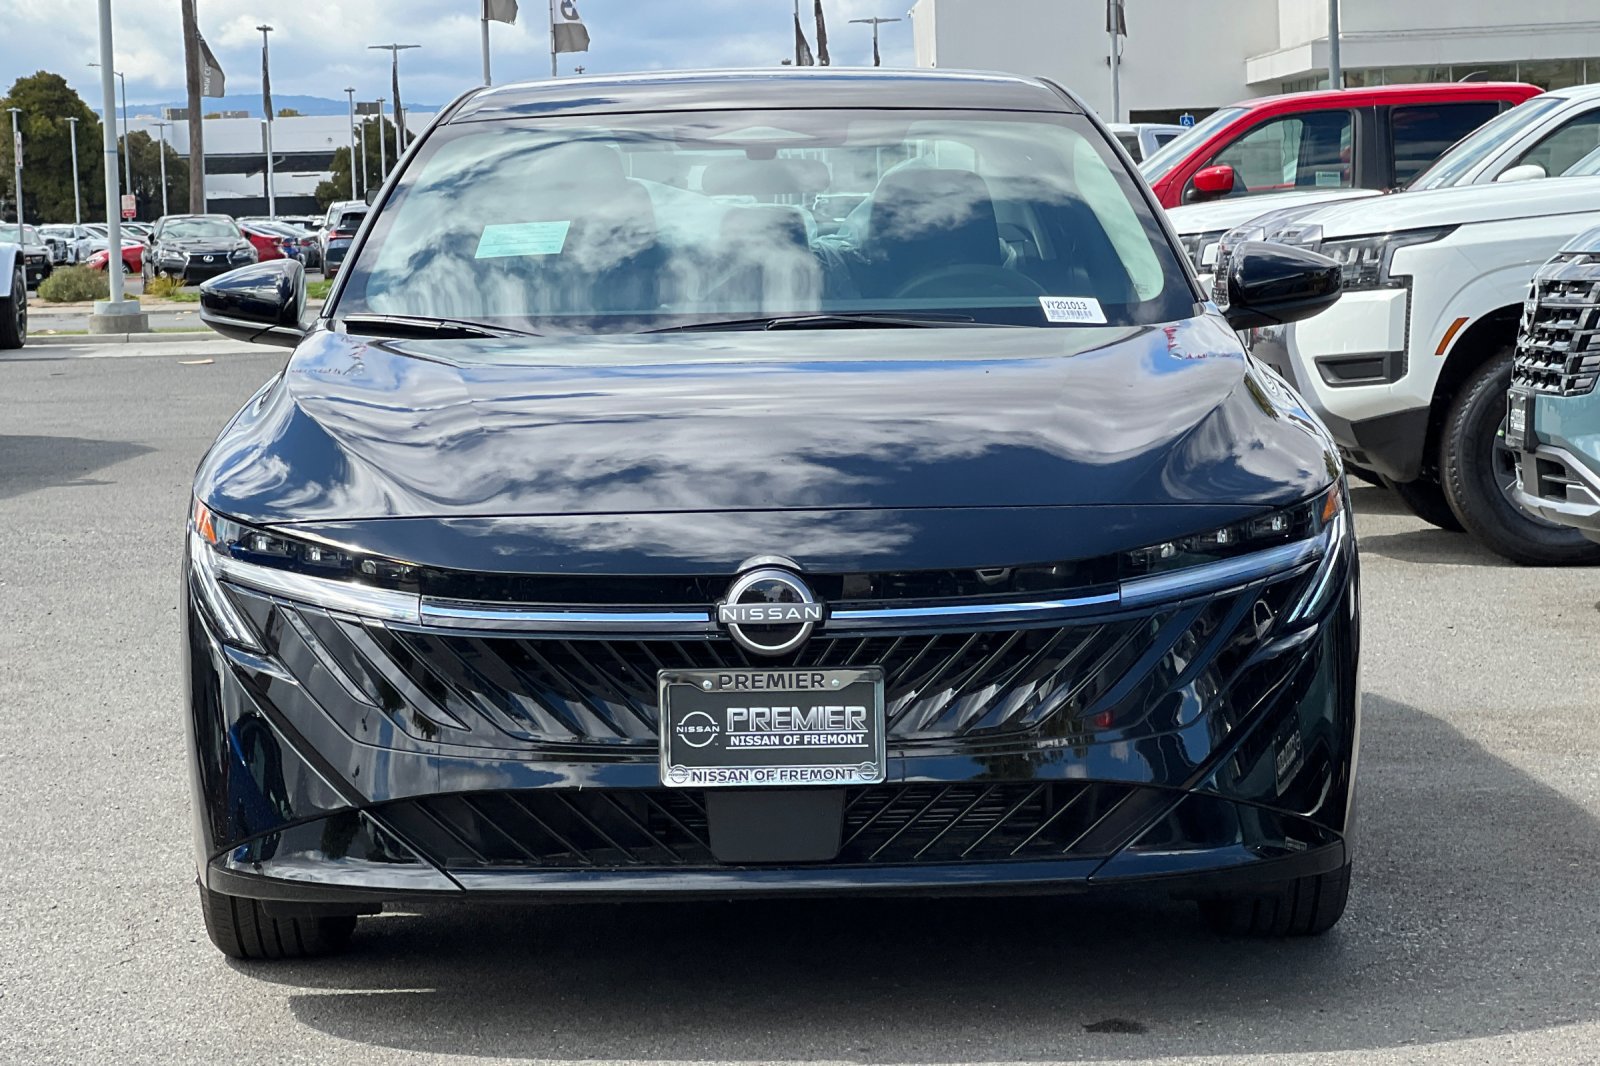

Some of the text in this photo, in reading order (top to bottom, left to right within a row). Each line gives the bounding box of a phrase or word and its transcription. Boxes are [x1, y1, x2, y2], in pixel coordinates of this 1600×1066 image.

[1044, 301, 1087, 310] VY201013
[722, 606, 820, 621] NISSAN
[718, 673, 825, 690] PREMIER
[726, 705, 867, 732] PREMIER
[676, 725, 720, 733] NISSAN
[730, 734, 865, 746] NISSAN OF FREMONT
[692, 768, 856, 782] NISSAN OF FREMONT
